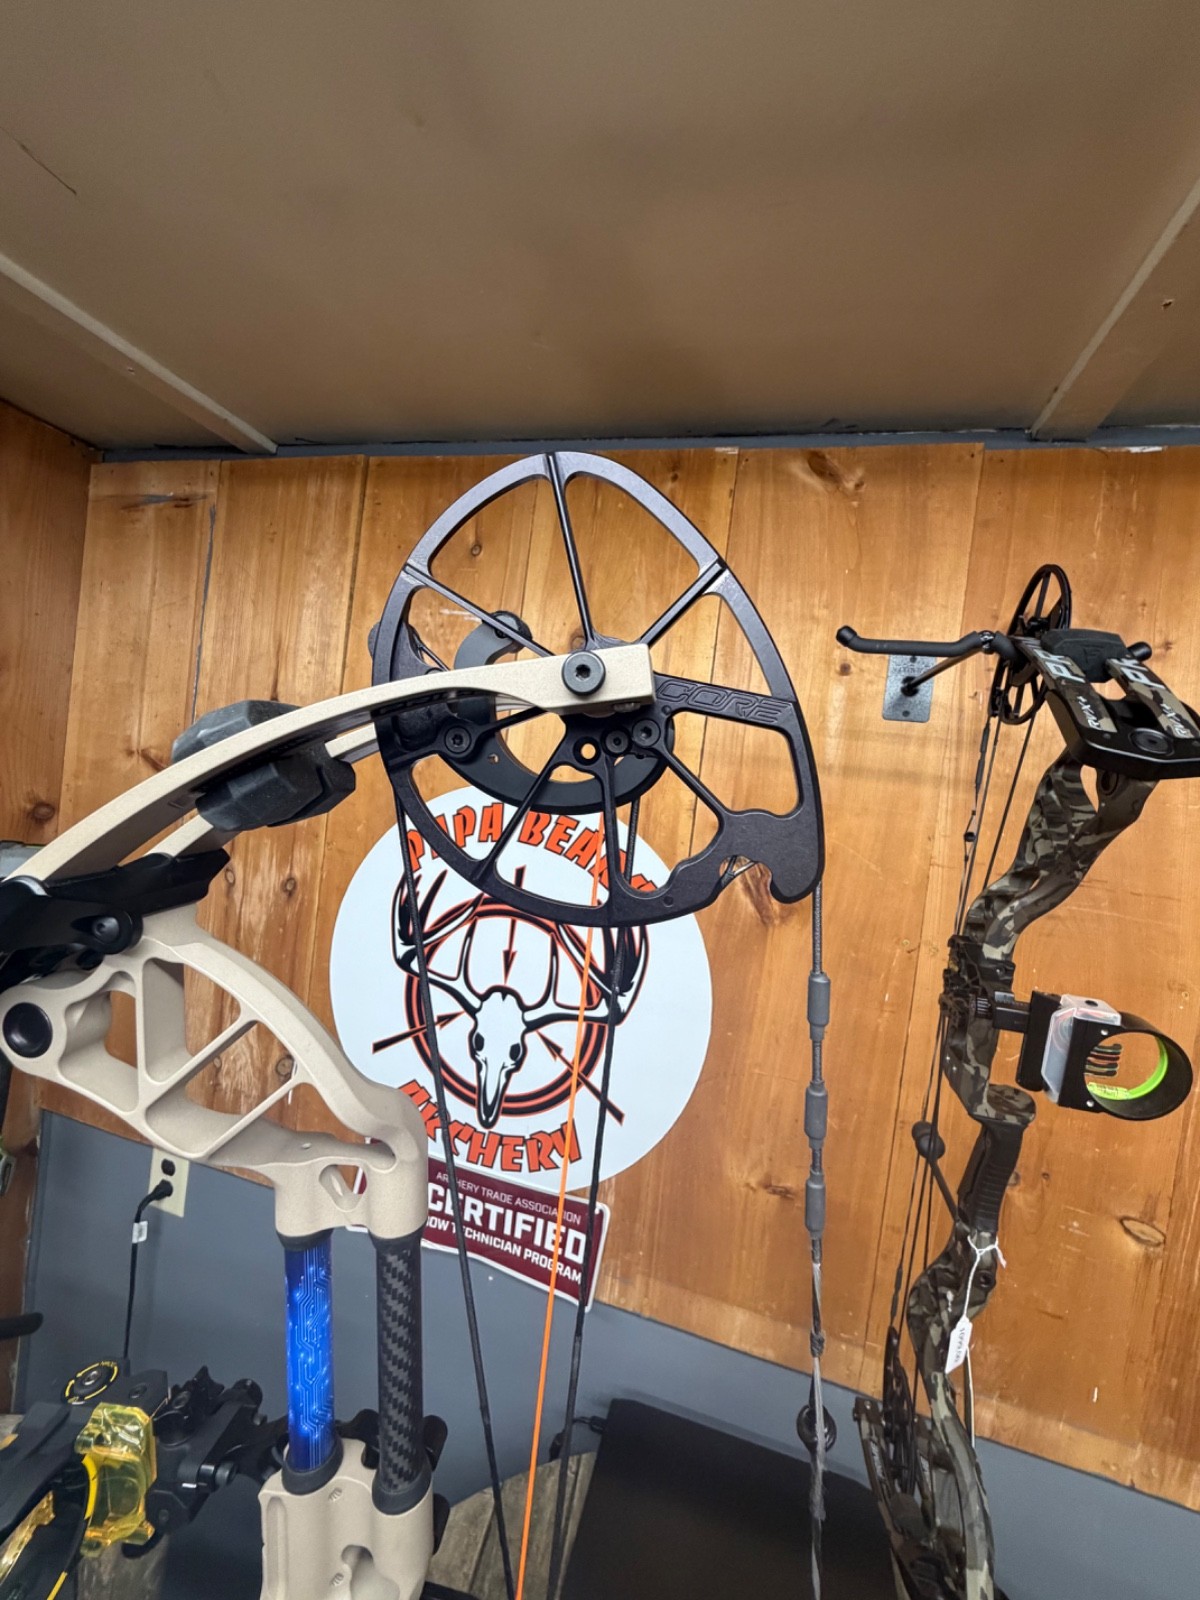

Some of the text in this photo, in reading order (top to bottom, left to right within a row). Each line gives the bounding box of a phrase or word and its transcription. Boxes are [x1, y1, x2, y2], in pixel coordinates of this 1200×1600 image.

[656, 679, 793, 724] CORE
[405, 801, 505, 873] PPA
[435, 1171, 582, 1226] ARHERY TRADE ASSOCIAION
[427, 1216, 450, 1231] OW
[451, 1221, 521, 1257] TCHNICIAN
